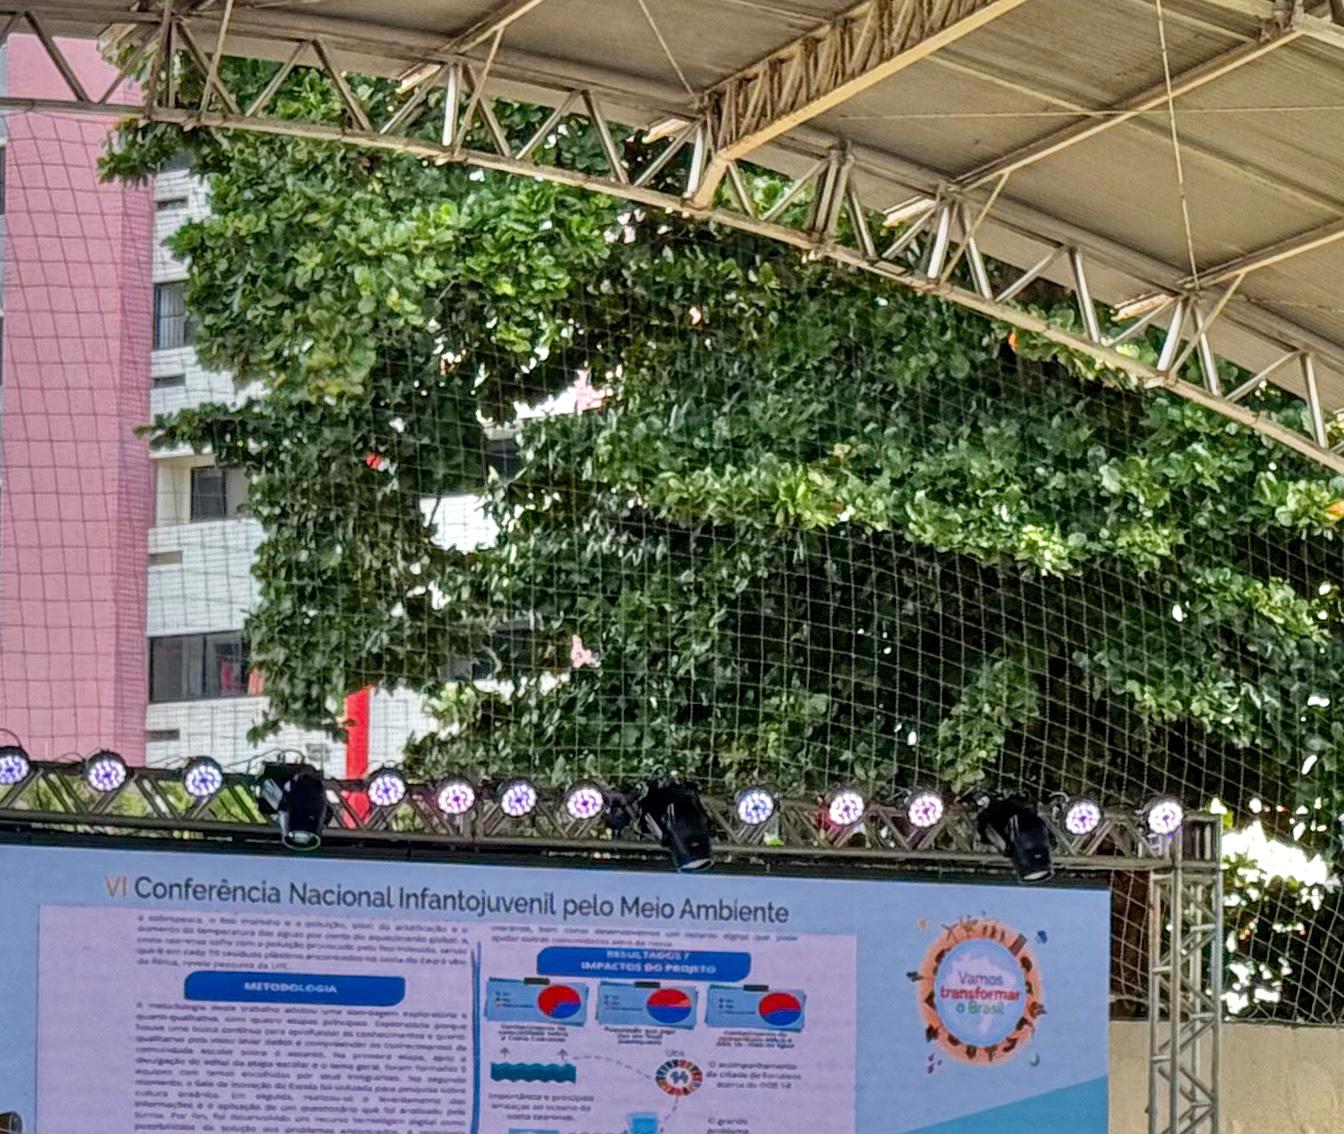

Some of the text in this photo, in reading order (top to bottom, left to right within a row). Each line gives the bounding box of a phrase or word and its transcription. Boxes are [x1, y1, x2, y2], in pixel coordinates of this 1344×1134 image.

[105, 875, 789, 924] VI Conferência Nacional Infantojuvenil pelo Meio Ambiente
[581, 961, 717, 975] IMPACTOS DO PROJETO
[958, 971, 1003, 986] Vamos
[244, 982, 338, 994] METODOLOGIA
[940, 986, 1020, 1001] transformar
[968, 1001, 1005, 1014] Brasil
